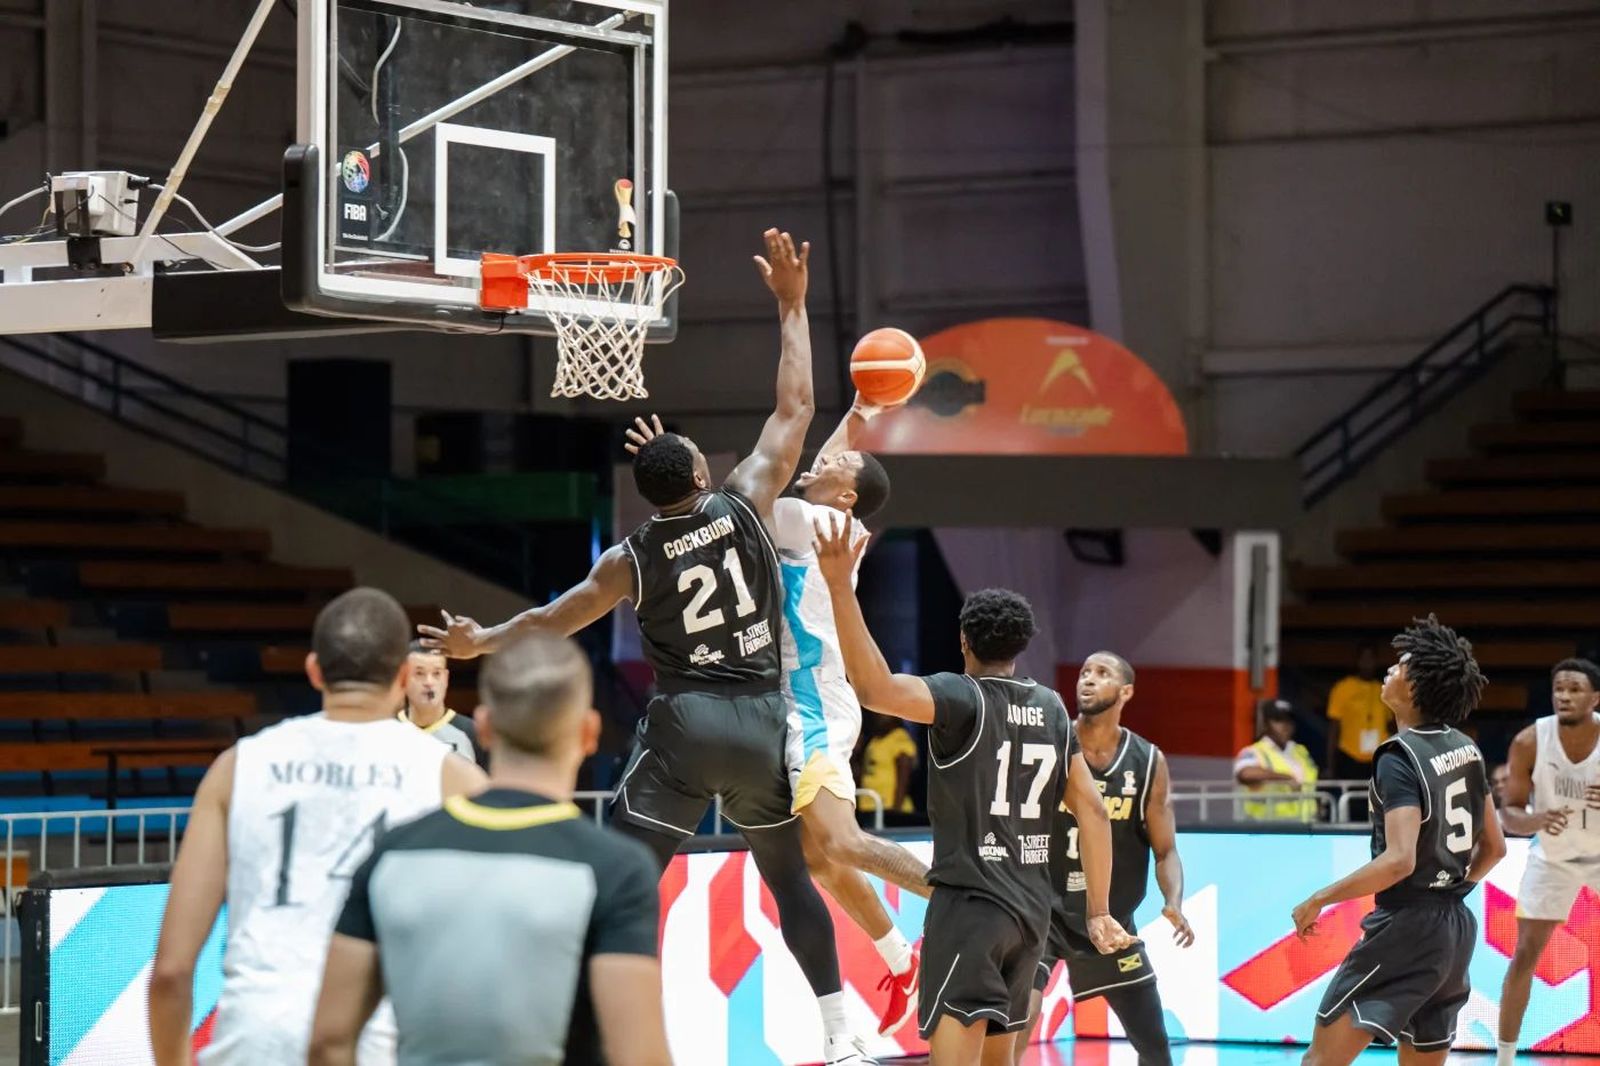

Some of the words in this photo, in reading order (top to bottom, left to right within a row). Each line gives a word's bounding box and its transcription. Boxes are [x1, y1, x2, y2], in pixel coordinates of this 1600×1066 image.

[344, 203, 367, 221] FIBA
[663, 514, 735, 559] COCKBURN
[677, 547, 757, 635] 21
[989, 740, 1058, 819] 17
[1026, 834, 1051, 849] STREET
[1445, 776, 1473, 854] 5
